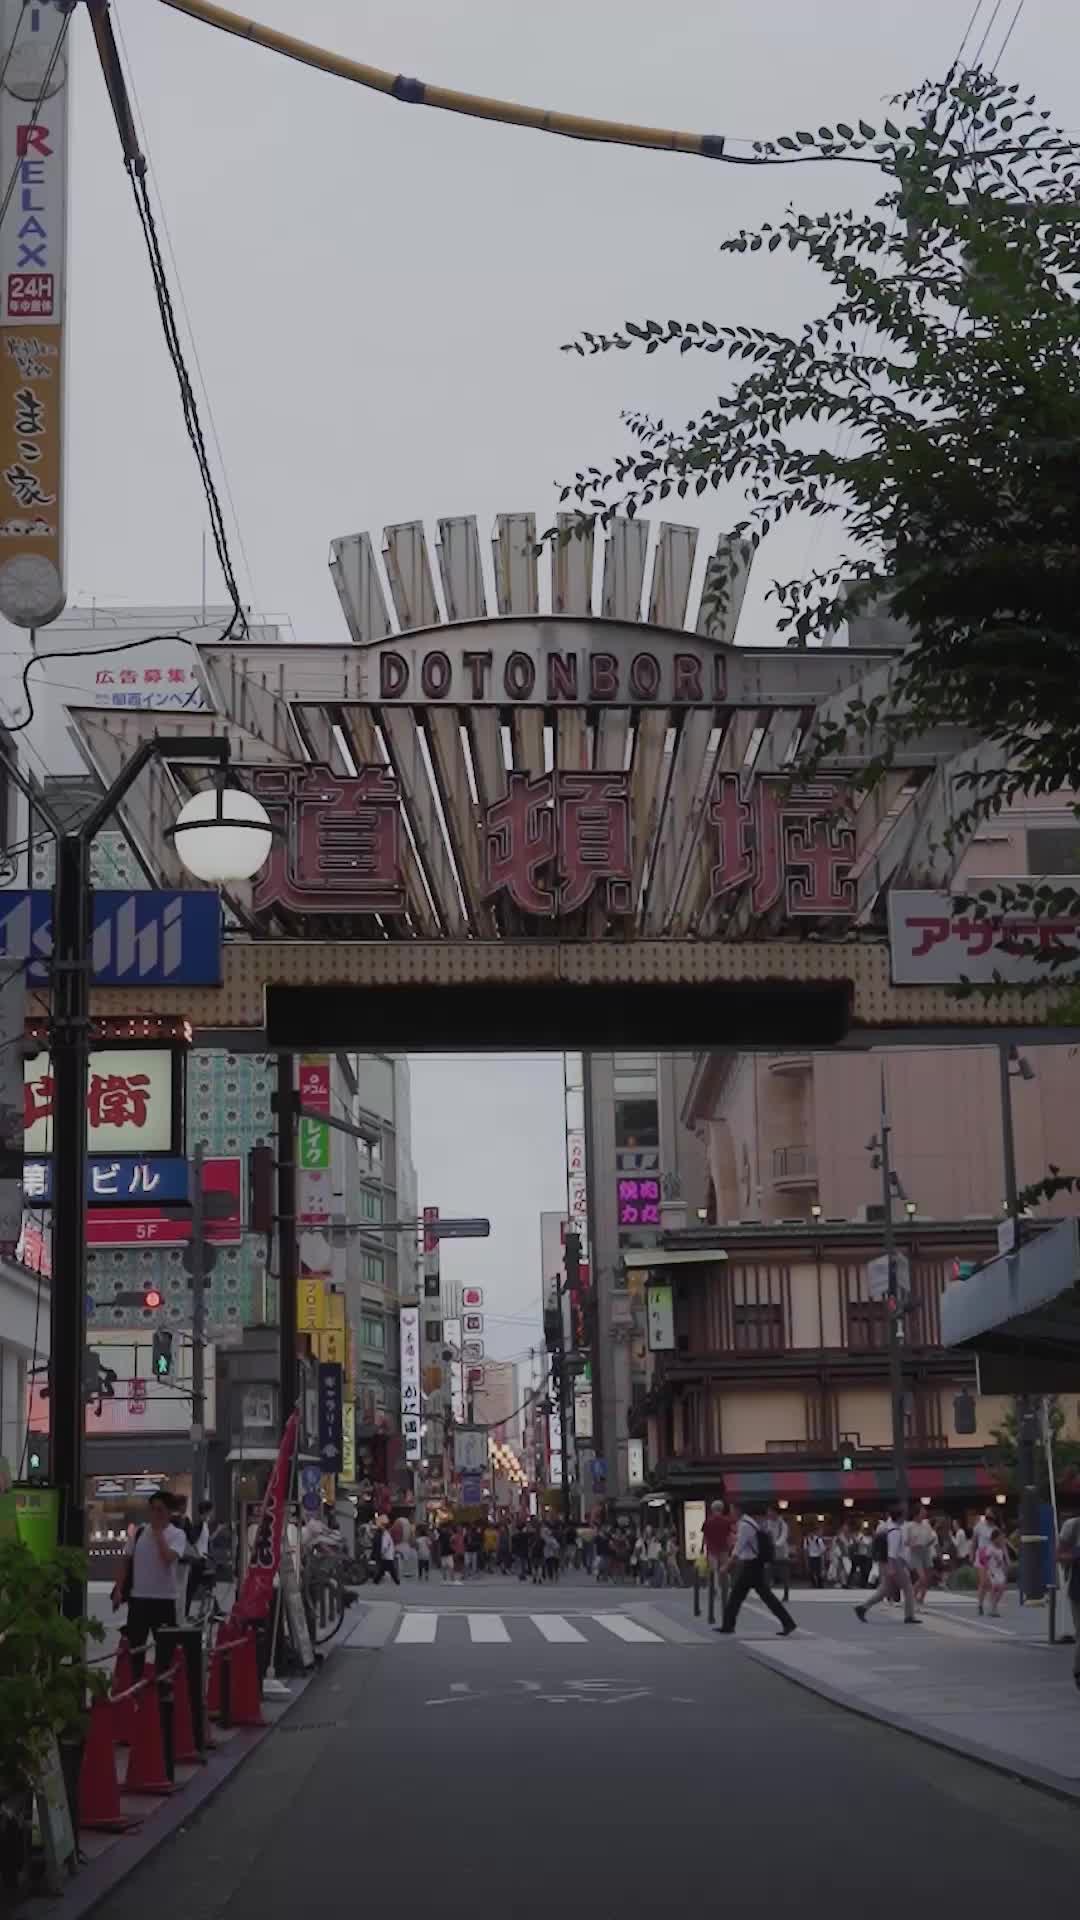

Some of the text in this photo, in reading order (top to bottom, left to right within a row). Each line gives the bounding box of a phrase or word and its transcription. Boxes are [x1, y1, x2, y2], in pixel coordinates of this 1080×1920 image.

[16, 125, 53, 267] RELAX
[11, 277, 52, 298] 24H
[379, 650, 729, 700] DOTONBORI
[253, 764, 858, 918] 道頓堀
[303, 1085, 327, 1094] アコム
[306, 1119, 322, 1163] レイク
[136, 1224, 157, 1239] 5F
